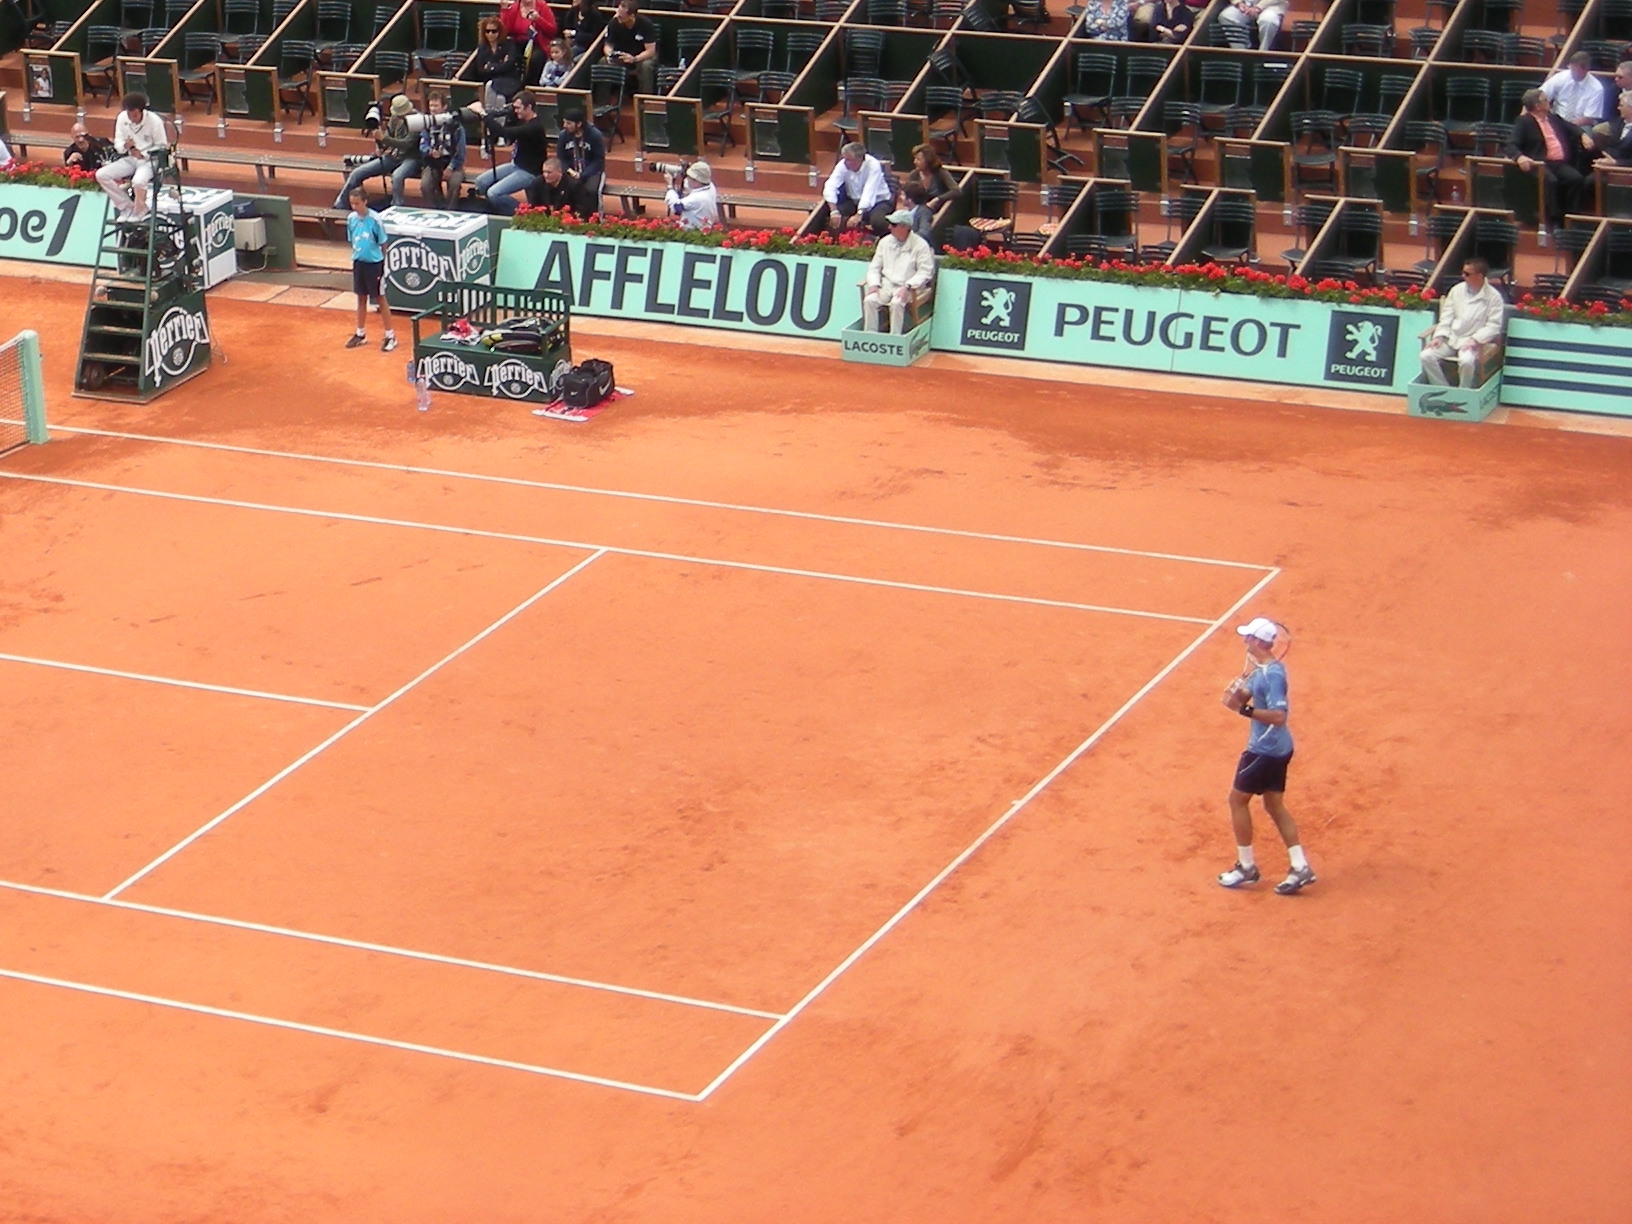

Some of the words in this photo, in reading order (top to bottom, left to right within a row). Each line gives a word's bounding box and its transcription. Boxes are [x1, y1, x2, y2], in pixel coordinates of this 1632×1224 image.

[534, 240, 837, 332] AFFLELOU
[967, 328, 1020, 344] PEUGEOT
[1054, 302, 1301, 359] PEUGEOT
[145, 311, 210, 387] Perrier
[844, 339, 904, 357] LACOSTE
[417, 354, 480, 388] Perrier
[484, 361, 548, 396] Perrier
[1331, 363, 1388, 379] PEUGEOT
